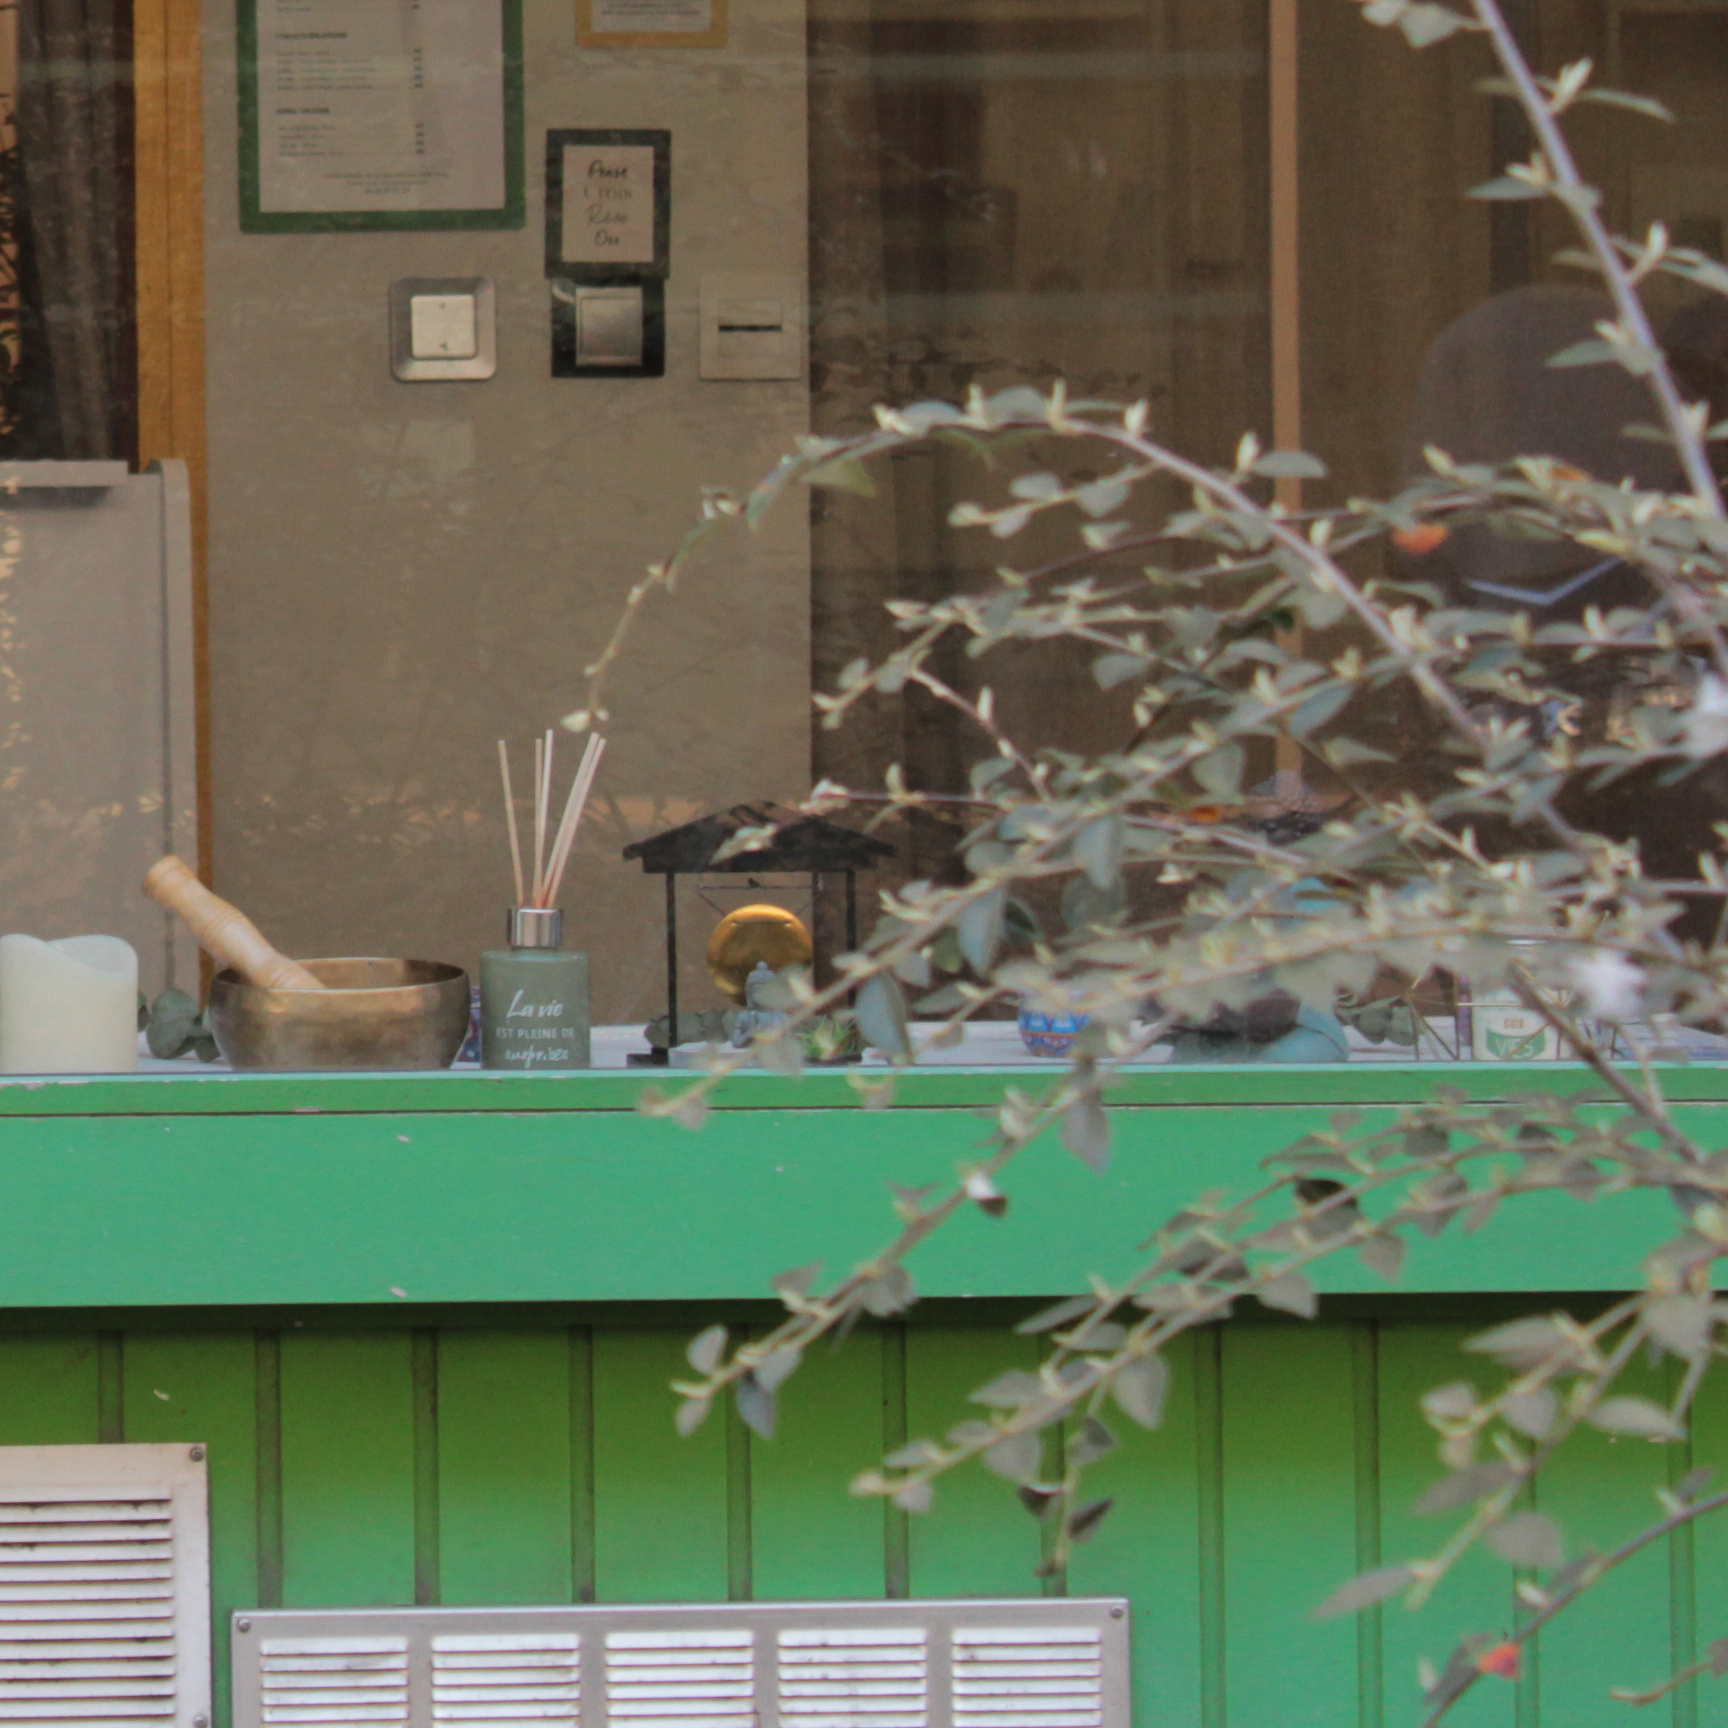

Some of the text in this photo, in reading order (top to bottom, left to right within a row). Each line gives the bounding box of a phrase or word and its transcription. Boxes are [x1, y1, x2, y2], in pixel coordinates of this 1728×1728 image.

[506, 988, 535, 1019] La
[496, 1027, 514, 1038] EST
[517, 1027, 558, 1040] PLEINE
